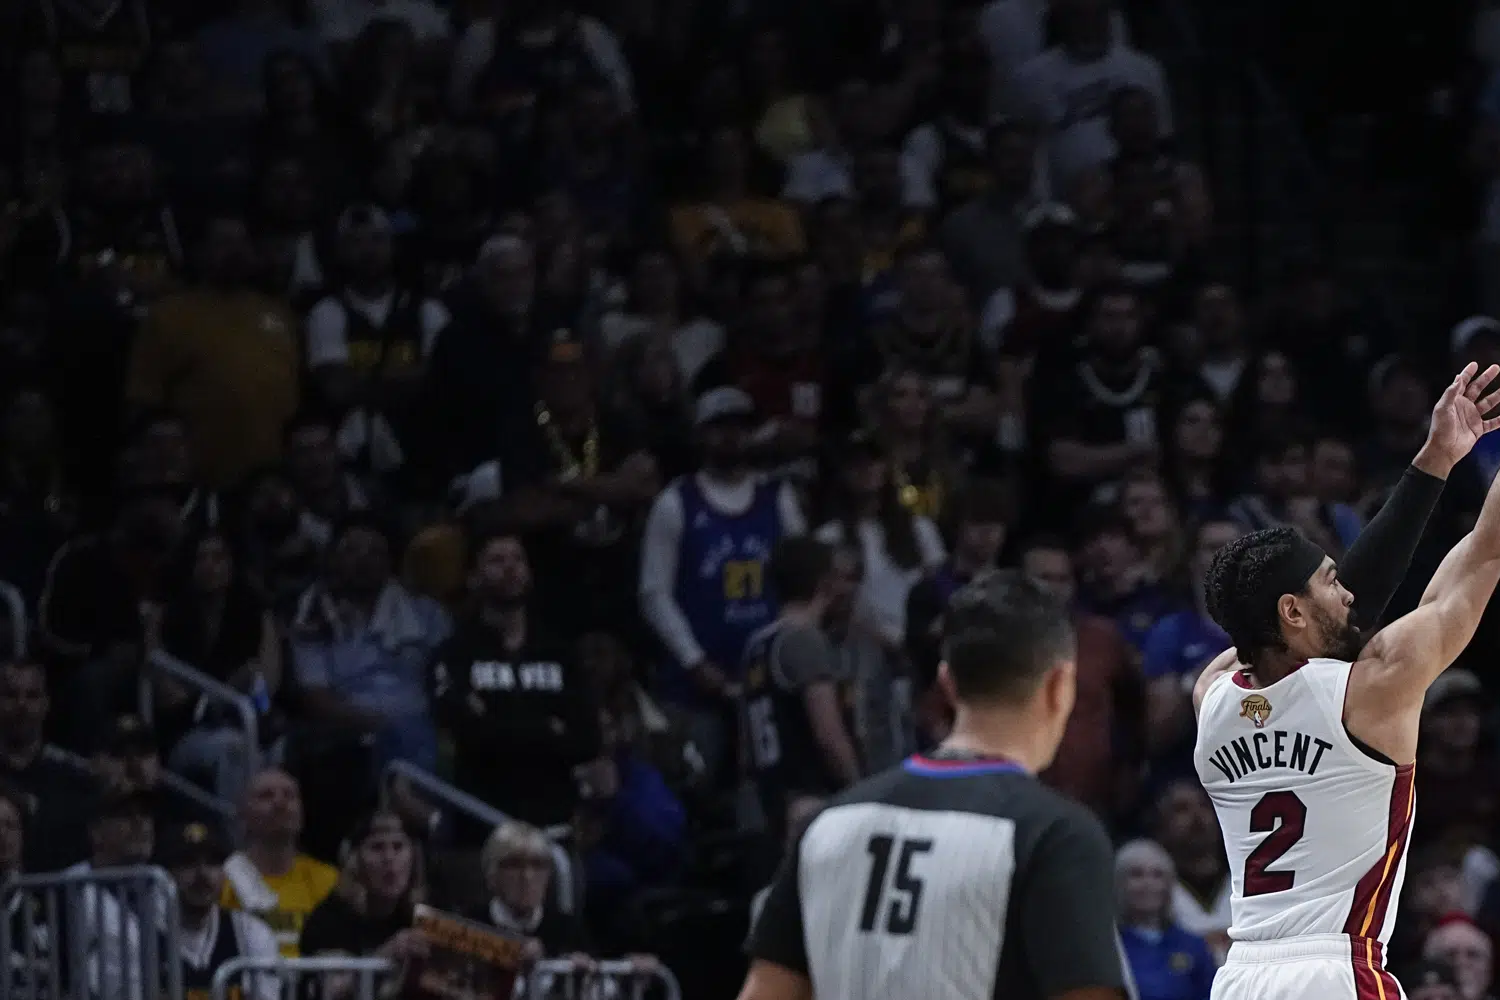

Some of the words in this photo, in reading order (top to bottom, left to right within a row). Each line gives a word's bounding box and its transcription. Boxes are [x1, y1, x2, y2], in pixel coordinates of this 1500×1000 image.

[1240, 700, 1272, 718] Finals
[1208, 730, 1333, 783] VINCENT
[1243, 790, 1307, 897] 2
[860, 835, 933, 934] 15
